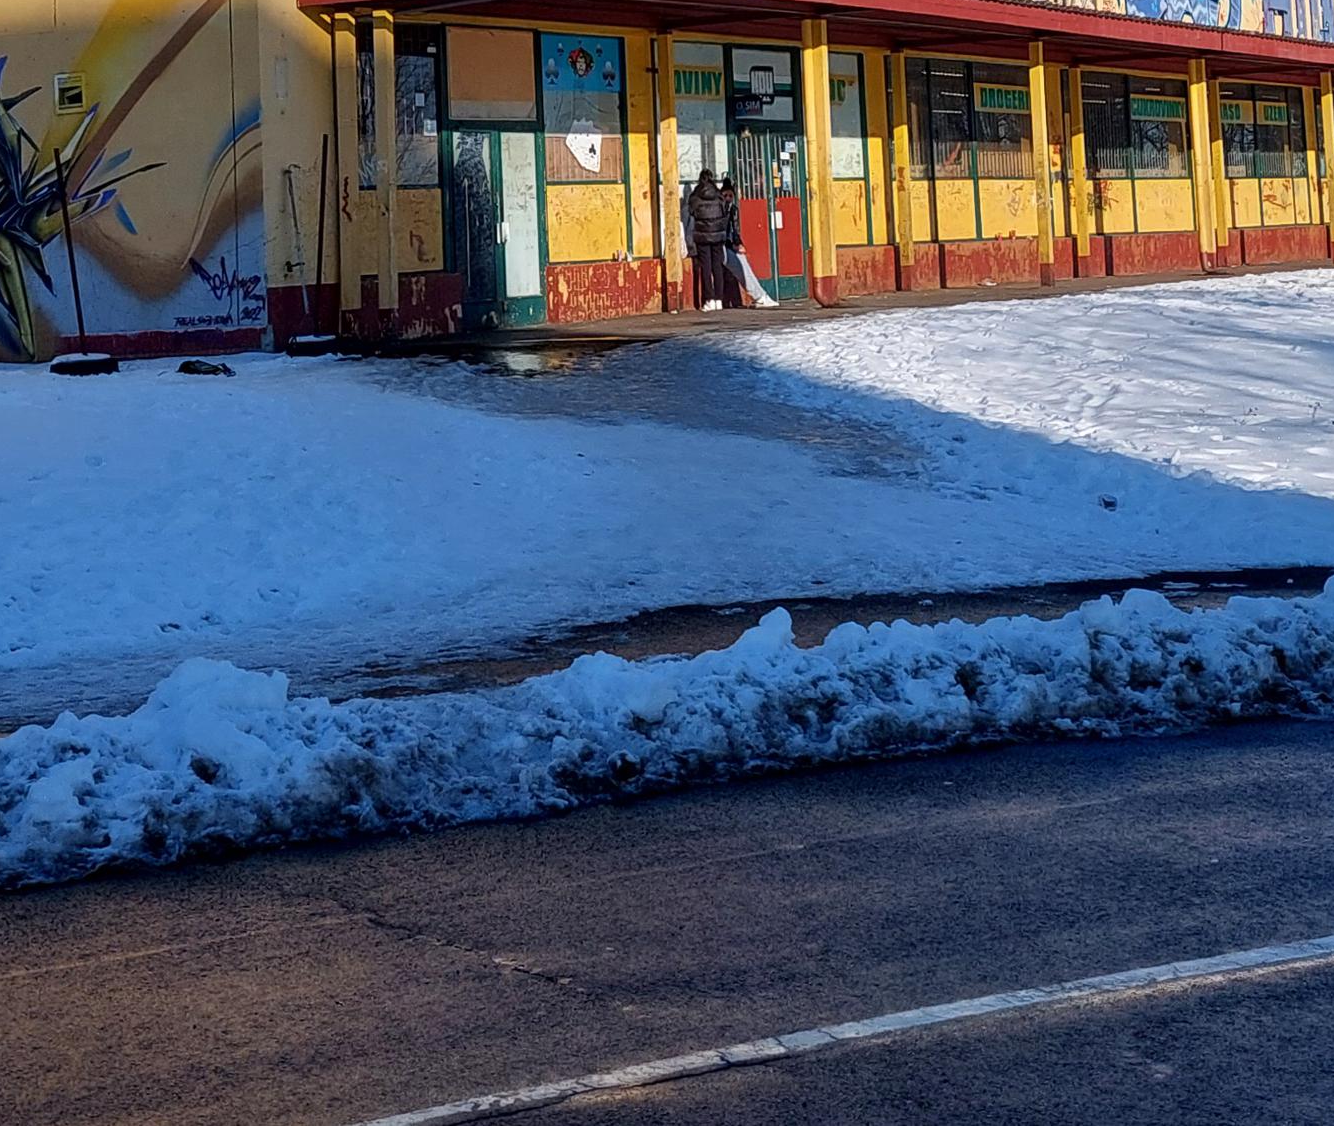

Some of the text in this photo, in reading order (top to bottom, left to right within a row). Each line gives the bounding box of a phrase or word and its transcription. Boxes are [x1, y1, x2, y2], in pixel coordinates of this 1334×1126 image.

[674, 69, 723, 96] OVINY
[980, 87, 1029, 111] DROGERI
[1220, 102, 1241, 122] ASO
